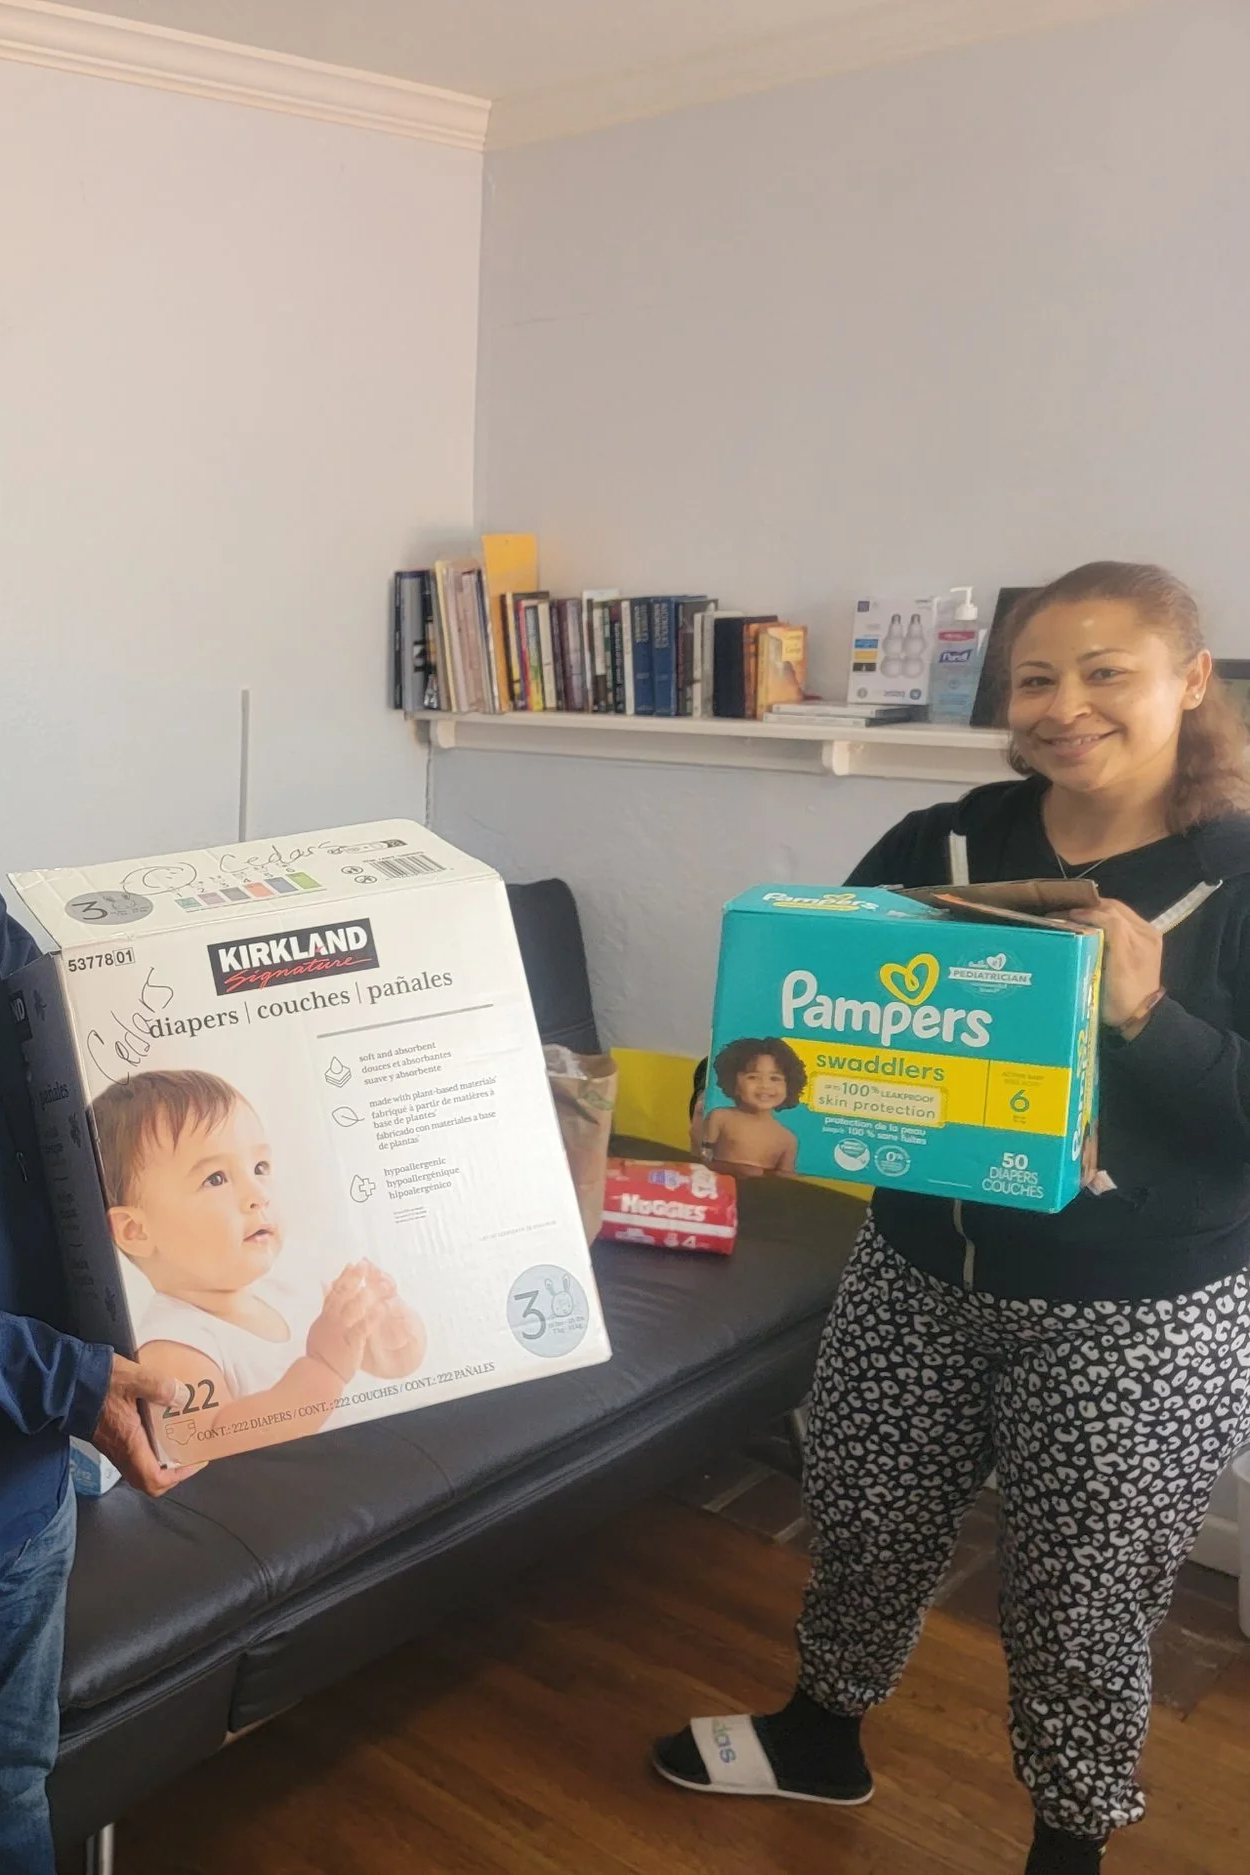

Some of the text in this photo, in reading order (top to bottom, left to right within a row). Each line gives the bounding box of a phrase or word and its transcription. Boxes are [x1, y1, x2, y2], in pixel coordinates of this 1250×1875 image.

[72, 900, 108, 921] 3
[762, 892, 880, 911] Pampers
[217, 925, 369, 974] KIRKLAND
[224, 955, 372, 994] Signature
[953, 970, 1028, 984] PEDIATRICIAN
[148, 969, 454, 1040] diapers couches pañales
[781, 969, 993, 1048] Pampers
[359, 1042, 437, 1063] soft and absorbent
[362, 1051, 452, 1074] douces et absorbantes
[364, 1075, 388, 1086] suave
[396, 1064, 442, 1080] absorbente
[816, 1054, 945, 1082] swaddlers
[369, 1093, 392, 1108] made
[392, 1092, 411, 1104] with
[412, 1083, 459, 1102] plant-based
[842, 1082, 880, 1097] 100%
[1009, 1089, 1030, 1113] 6
[371, 1106, 407, 1120] fabriqué
[415, 1098, 440, 1113] partir
[441, 1095, 452, 1106] de
[453, 1090, 489, 1104] matières
[818, 1095, 936, 1120] skin protection
[373, 1118, 393, 1129] base
[393, 1115, 405, 1125] de
[376, 1126, 415, 1141] fabricado
[415, 1124, 431, 1134] con
[431, 1116, 472, 1130] materiales
[479, 1111, 497, 1121] base
[378, 1141, 389, 1151] de
[383, 1156, 447, 1177] hypoallergenic
[1001, 1152, 1029, 1170] 50
[385, 1166, 461, 1189] hypoallergénique
[989, 1166, 1039, 1185] DIAPERS
[388, 1178, 452, 1200] hipoalergénico
[981, 1178, 1045, 1200] COUCHES
[513, 1289, 547, 1340] 3
[232, 1420, 250, 1435] 222
[250, 1411, 293, 1430] DIAPERS
[334, 1396, 351, 1410] 222
[351, 1385, 399, 1405] COUCHES
[437, 1371, 454, 1385] 222
[454, 1361, 496, 1381] PAÑALES
